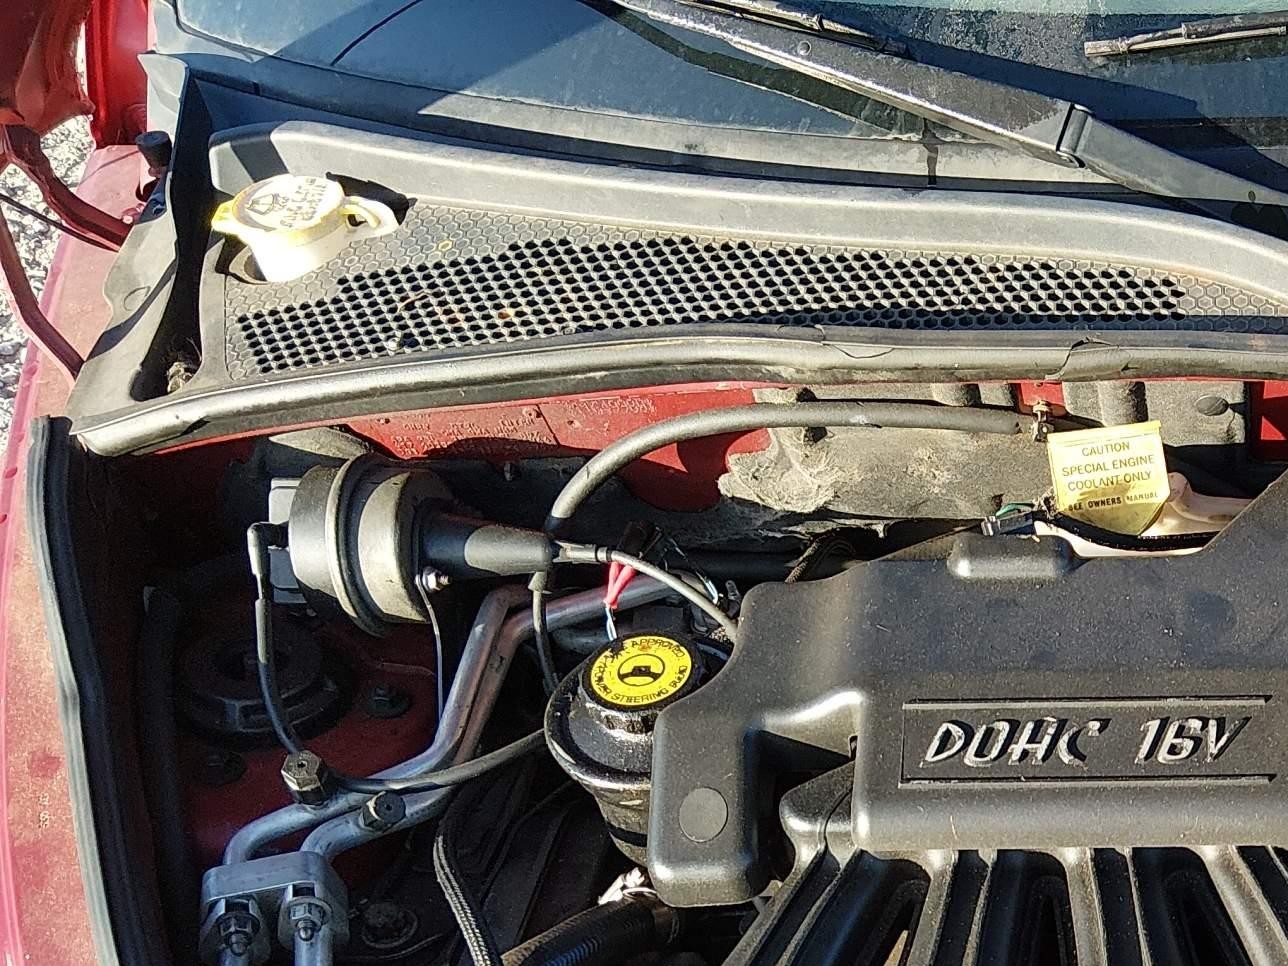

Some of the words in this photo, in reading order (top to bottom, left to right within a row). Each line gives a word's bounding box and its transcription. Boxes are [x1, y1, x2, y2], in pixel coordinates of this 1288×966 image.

[1082, 441, 1130, 456] CAUTION
[1062, 462, 1110, 477] SPECIAL
[1112, 454, 1155, 469] ENGINE
[1067, 474, 1121, 492] COOLANT
[1123, 471, 1152, 484] ONLY
[1068, 501, 1083, 512] SEE
[1087, 496, 1122, 509] OWNERS
[1126, 491, 1158, 502] MANUAL
[631, 638, 686, 658] APPROVED
[611, 687, 669, 703] STEERING
[920, 717, 1112, 770] DOHC
[1134, 716, 1252, 764] 16V
